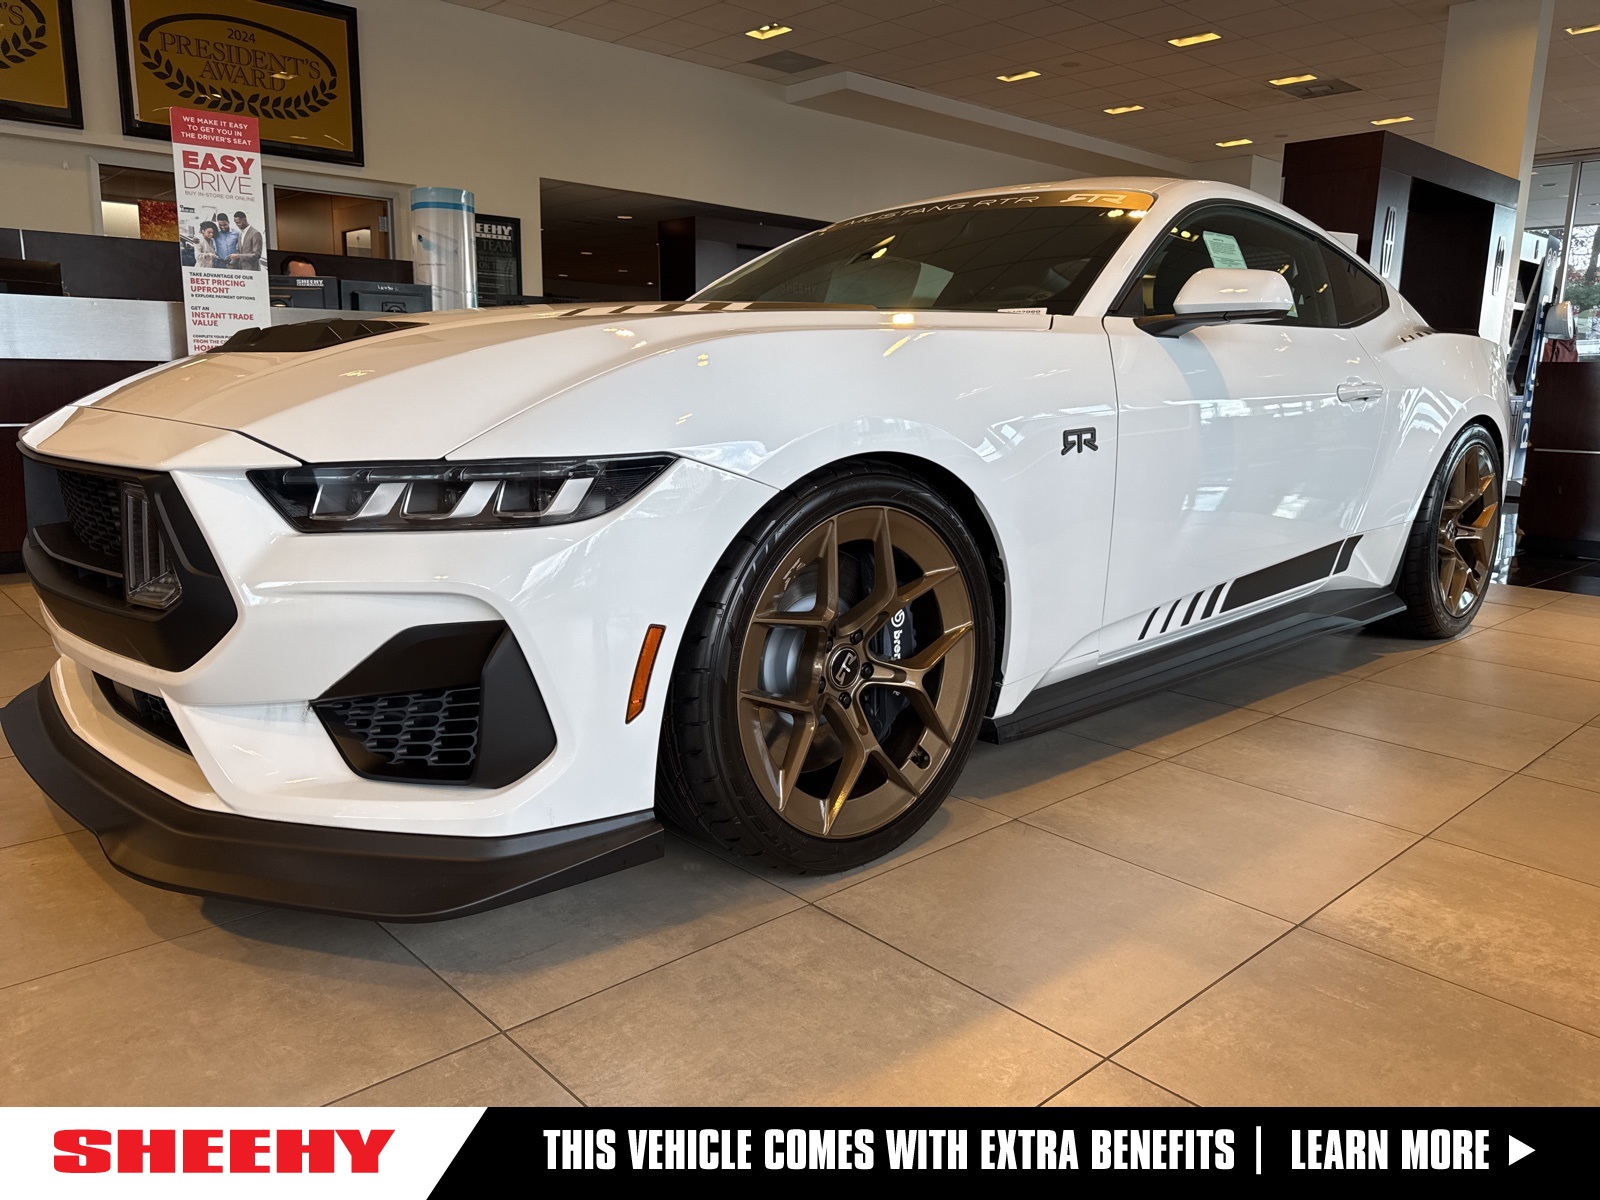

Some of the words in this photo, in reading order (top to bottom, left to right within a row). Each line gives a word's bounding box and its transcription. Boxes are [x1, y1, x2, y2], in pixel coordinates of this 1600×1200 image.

[227, 28, 256, 43] 2024
[159, 31, 321, 80] PRESIDENT'S
[199, 60, 286, 92] AWARD
[197, 118, 218, 126] MAKE
[229, 122, 248, 130] EASY
[181, 131, 196, 139] THE
[197, 133, 231, 144] DRIVER'S
[233, 138, 251, 146] SEAT
[217, 128, 232, 136] YOU
[182, 150, 255, 175] EASY
[183, 170, 253, 196] DRIVE
[198, 191, 224, 199] IN-STORE
[844, 201, 970, 227] MUSTANG
[972, 196, 1040, 208] RTR
[483, 240, 512, 252] TEAM
[212, 279, 246, 287] PRICING
[191, 311, 227, 319] INSTANT
[192, 319, 218, 327] VALUE
